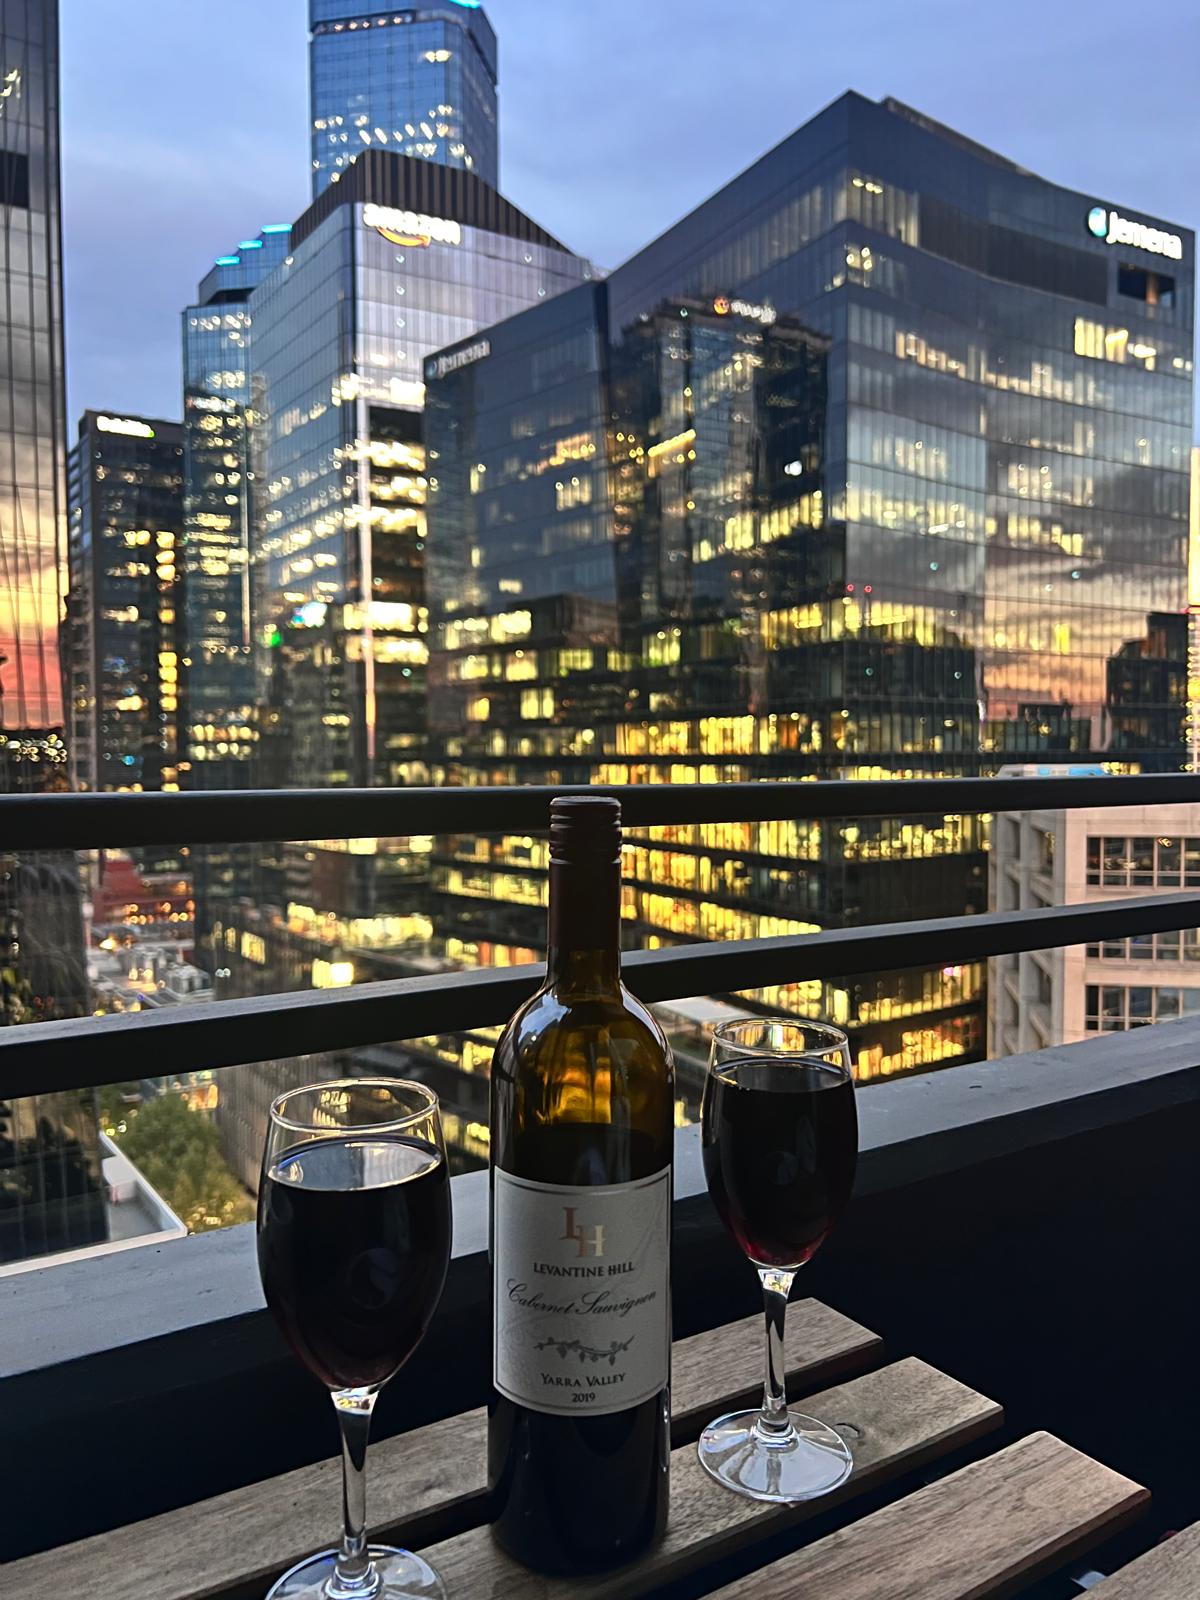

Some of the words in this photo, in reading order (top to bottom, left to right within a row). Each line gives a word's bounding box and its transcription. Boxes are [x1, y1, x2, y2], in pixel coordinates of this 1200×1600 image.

[533, 1262, 605, 1278] LEVANTINE
[608, 1261, 635, 1276] HILL
[507, 1278, 575, 1315] Cabernet
[575, 1290, 657, 1318] Sauvignon
[541, 1372, 581, 1387] YARRA
[586, 1372, 626, 1387] VALLEY
[571, 1392, 596, 1403] 2019
